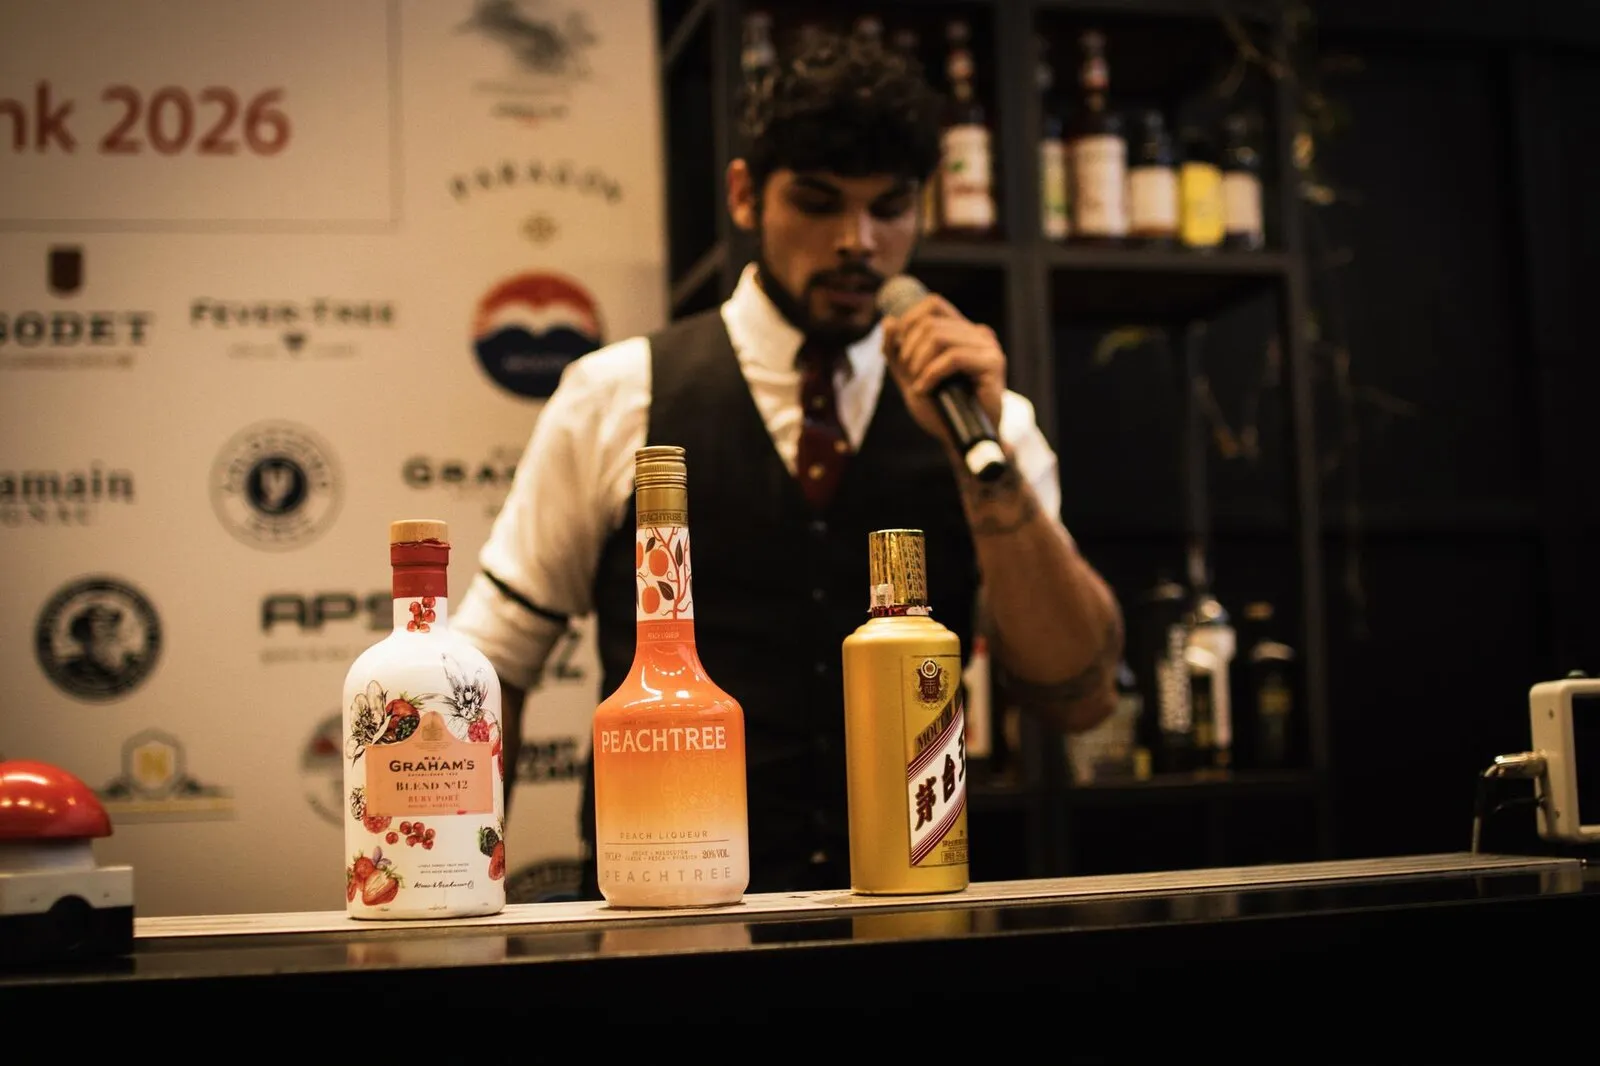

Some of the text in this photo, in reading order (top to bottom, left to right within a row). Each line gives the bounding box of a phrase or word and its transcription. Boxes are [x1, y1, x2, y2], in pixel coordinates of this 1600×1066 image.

[100, 83, 293, 155] 2026
[601, 726, 727, 753] PEACHTREE
[389, 759, 475, 773] GRAHAM'S
[396, 781, 439, 791] BLEND
[620, 830, 708, 840] PEACH LIQUEUR
[604, 867, 731, 882] PEACHTREE
